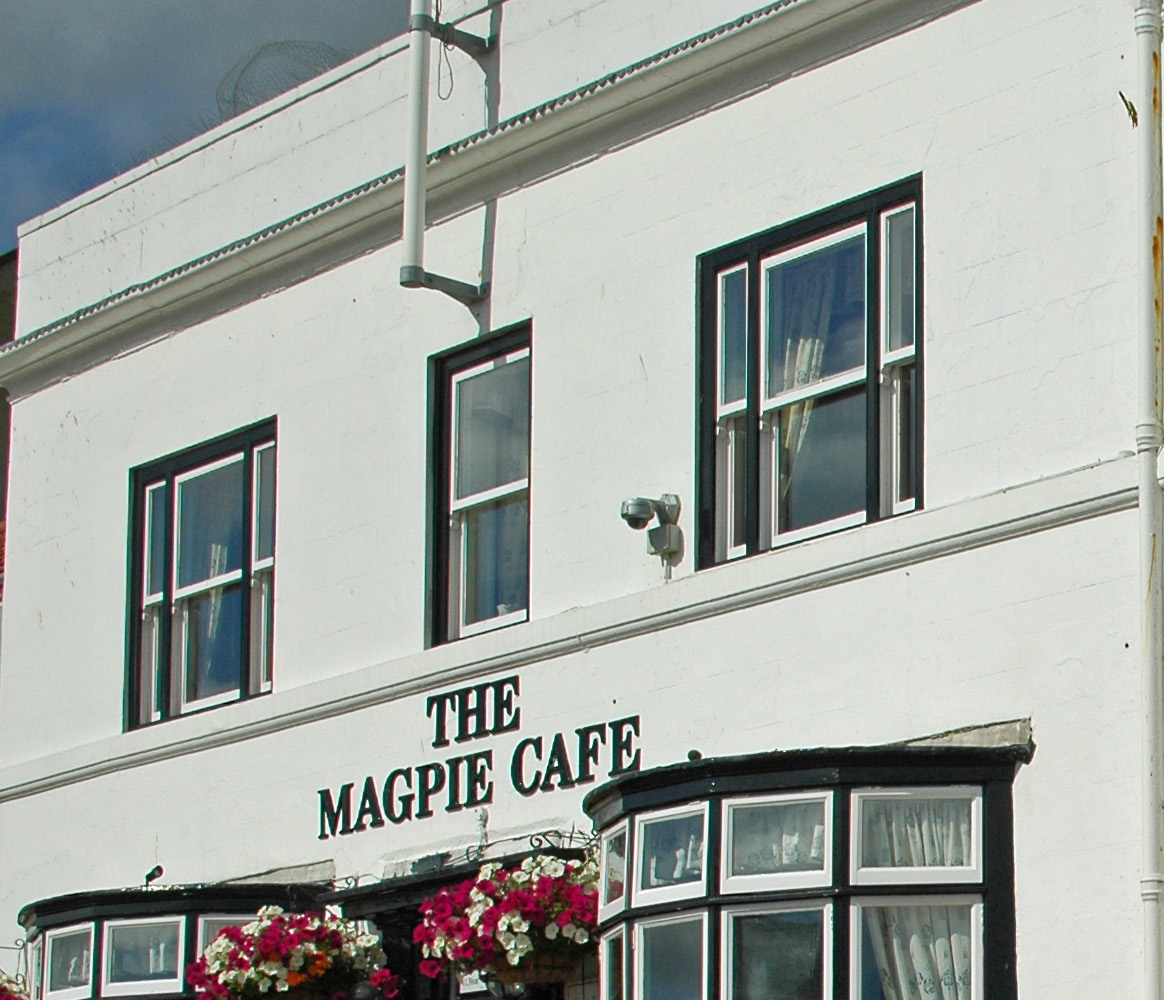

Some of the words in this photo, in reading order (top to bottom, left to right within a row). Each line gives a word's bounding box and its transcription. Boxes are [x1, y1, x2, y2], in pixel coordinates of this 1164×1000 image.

[426, 676, 521, 747] THE
[317, 750, 494, 841] MAGPIE
[511, 716, 642, 796] CAFE
